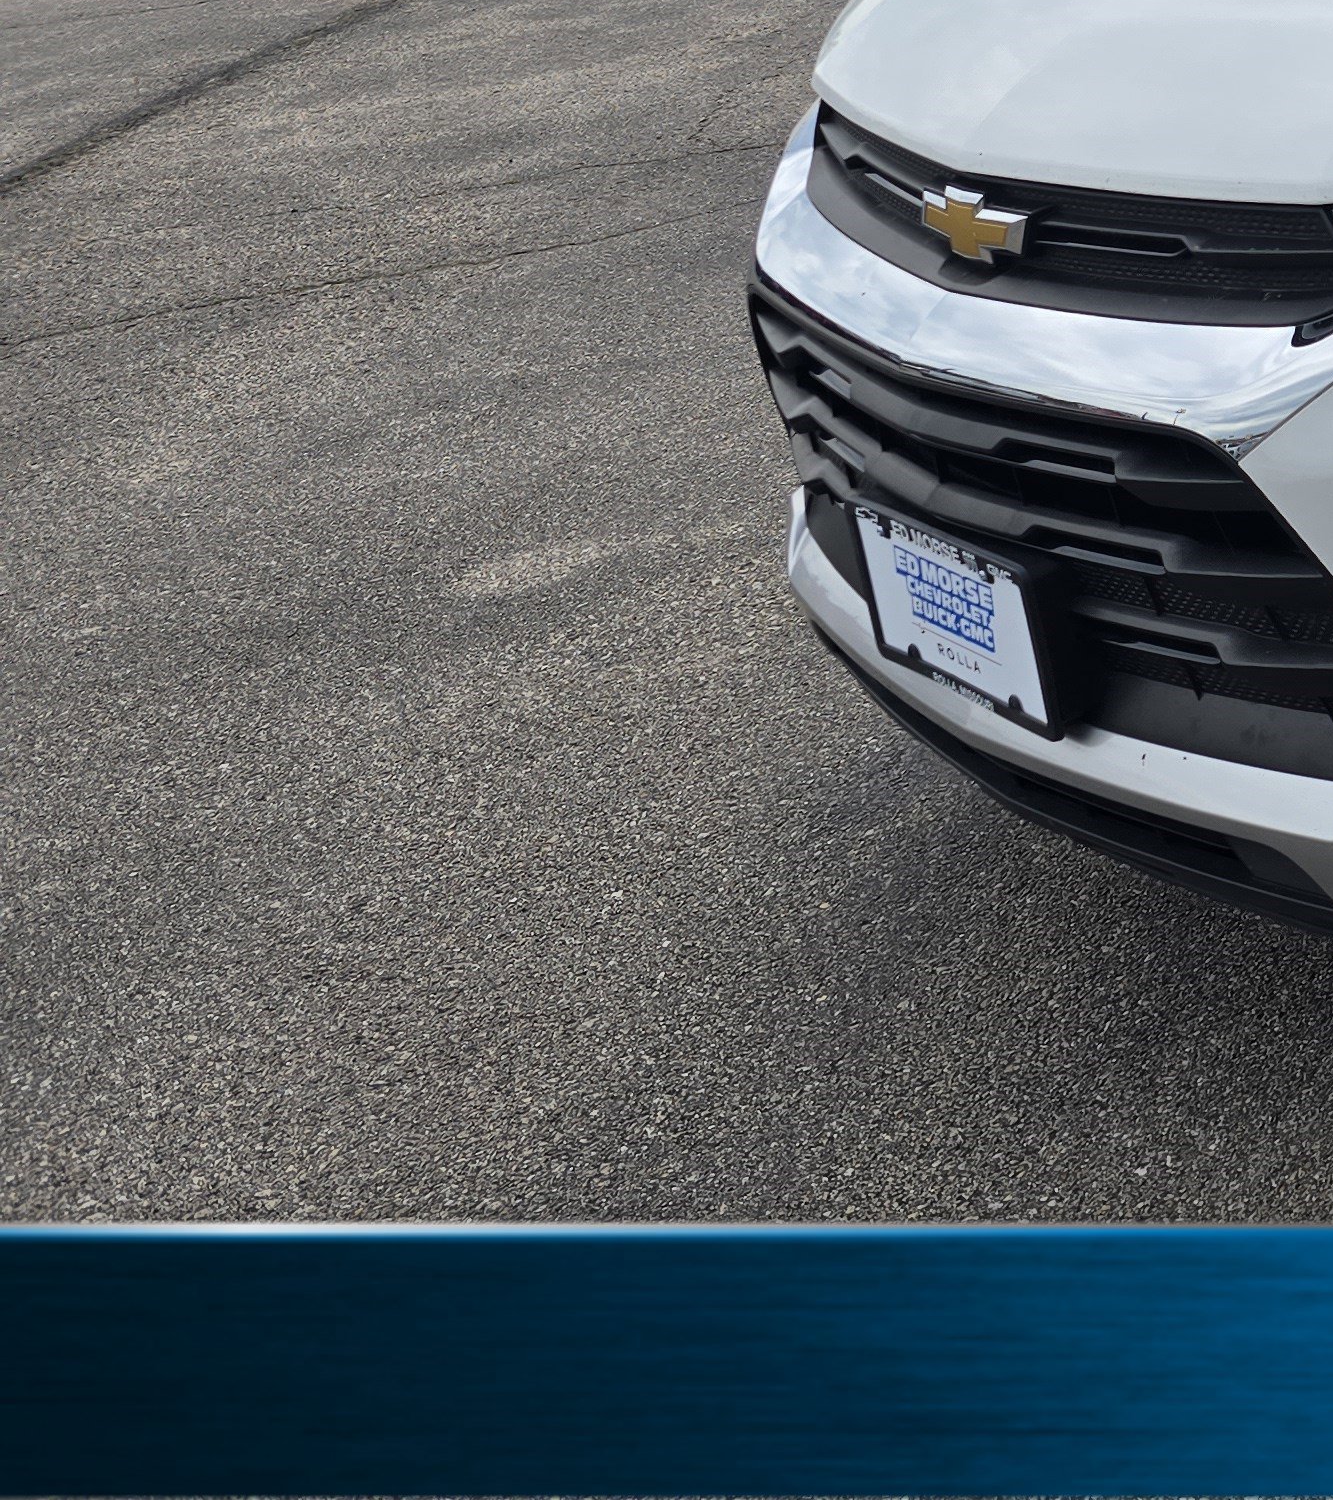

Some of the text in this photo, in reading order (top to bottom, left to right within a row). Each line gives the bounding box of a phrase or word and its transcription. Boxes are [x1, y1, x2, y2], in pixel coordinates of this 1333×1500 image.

[894, 545, 920, 578] ED
[920, 557, 994, 614] MORSE
[906, 575, 990, 627] CHEVROLET
[937, 642, 981, 674] ROLLA
